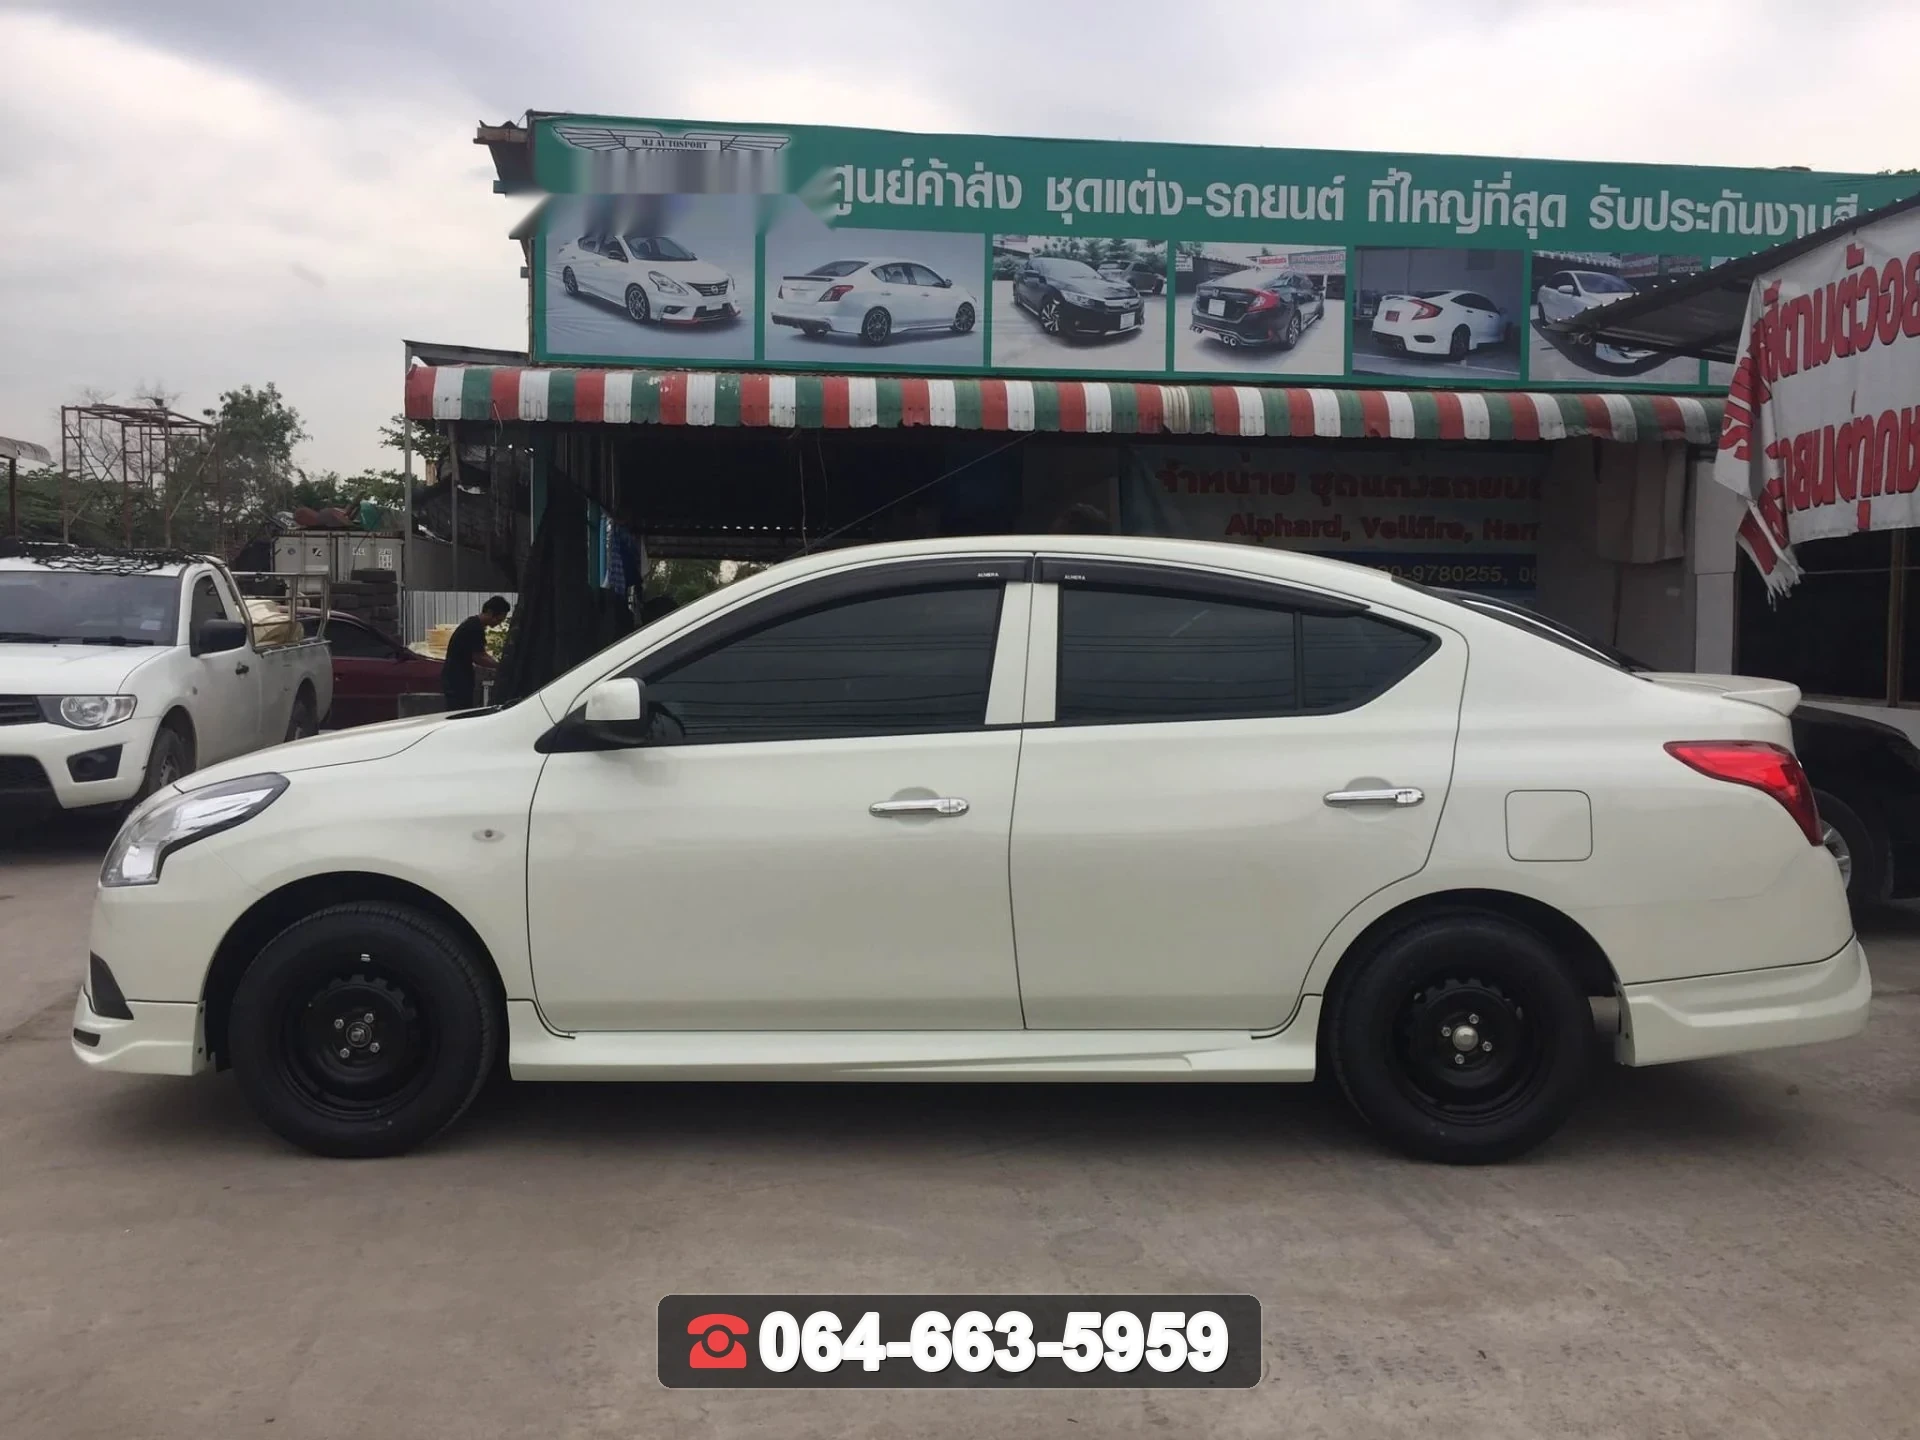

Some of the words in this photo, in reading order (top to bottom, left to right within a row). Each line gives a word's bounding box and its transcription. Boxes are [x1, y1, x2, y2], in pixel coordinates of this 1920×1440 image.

[641, 138, 653, 147] MJ
[654, 139, 708, 149] AUTOSPORT
[1046, 168, 1345, 225] ชุดแต่ง-รถยนต์
[1224, 512, 1351, 543] Alphard,
[1359, 514, 1474, 544] Vellfire,
